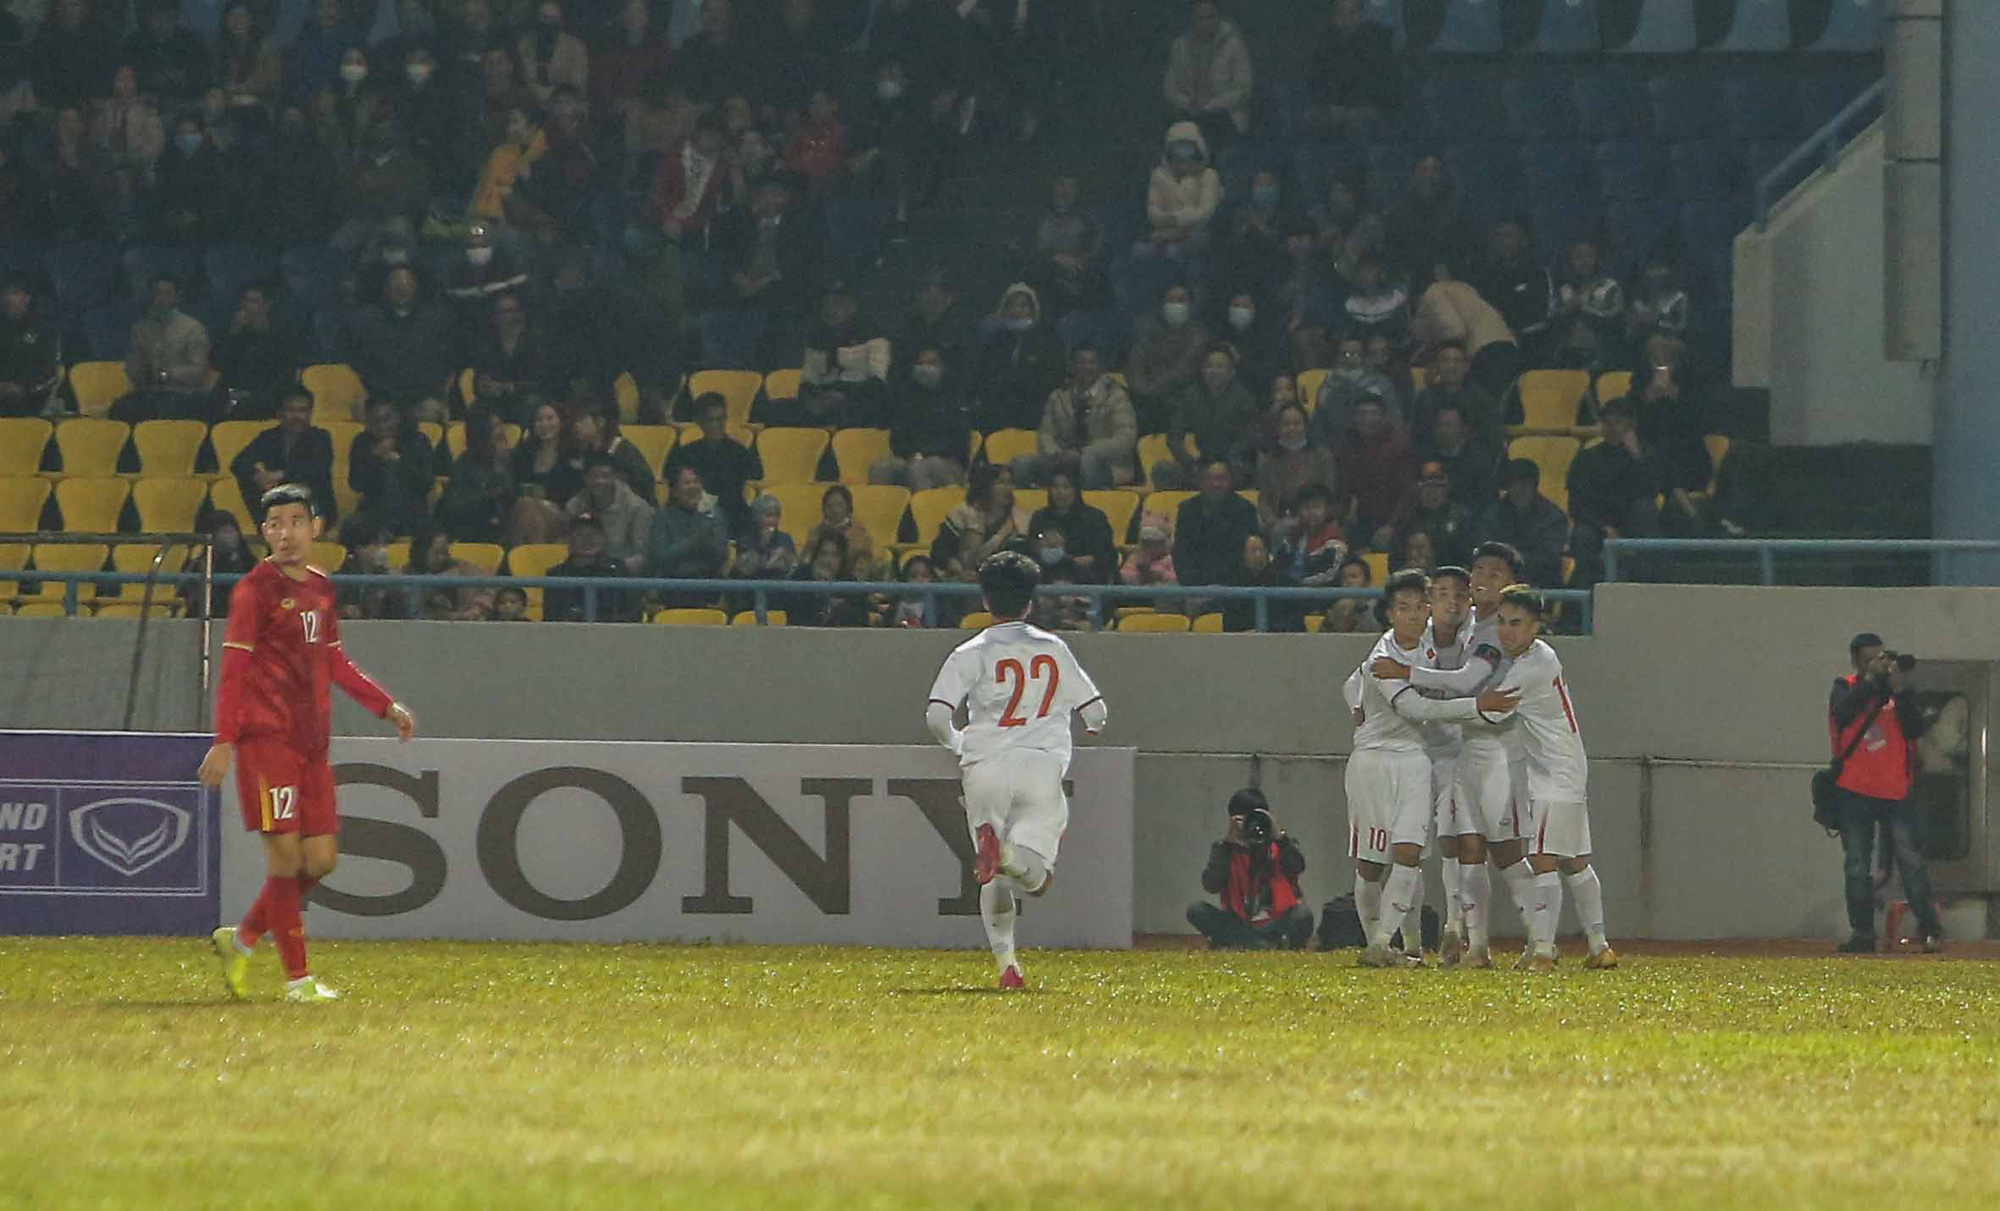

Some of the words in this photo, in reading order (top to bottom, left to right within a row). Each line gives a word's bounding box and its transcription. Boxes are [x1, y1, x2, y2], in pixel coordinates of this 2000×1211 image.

[300, 611, 318, 642] 12
[995, 654, 1059, 728] 22
[269, 786, 294, 820] 12
[300, 762, 1074, 917] SONY
[1369, 826, 1387, 852] 10
